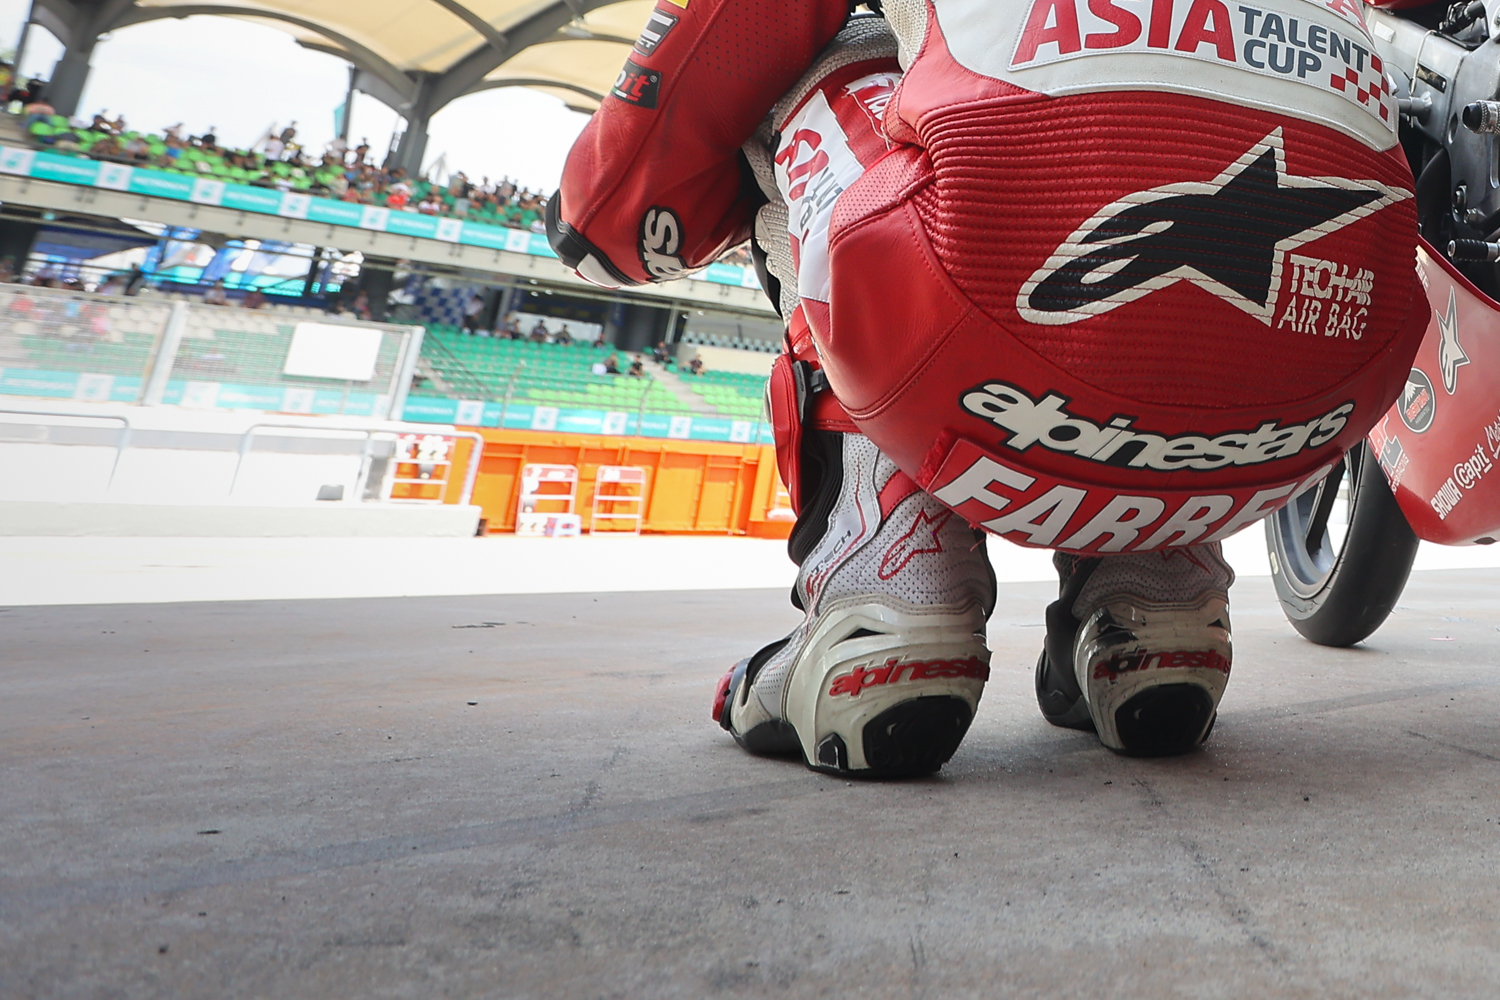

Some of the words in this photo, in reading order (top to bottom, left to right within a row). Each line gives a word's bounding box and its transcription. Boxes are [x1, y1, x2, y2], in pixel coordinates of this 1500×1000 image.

[1238, 5, 1369, 73] TALENT
[1243, 39, 1322, 80] CUP
[1277, 295, 1322, 336] AIR
[1324, 303, 1368, 340] BAG
[961, 383, 1355, 471] alpinestars
[1430, 477, 1464, 520] SHOWA
[828, 655, 989, 697] alpinesta
